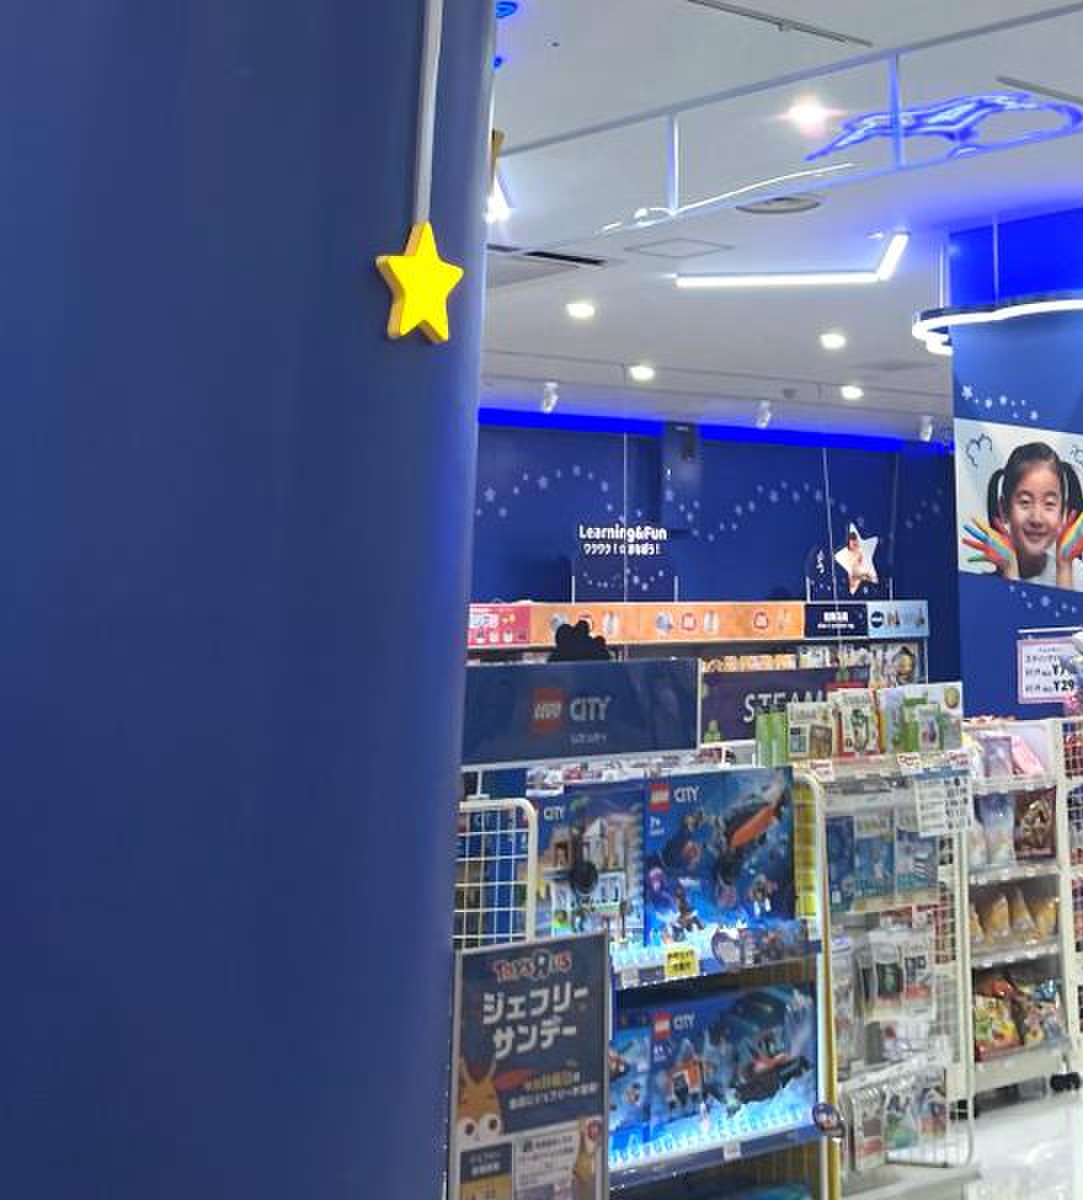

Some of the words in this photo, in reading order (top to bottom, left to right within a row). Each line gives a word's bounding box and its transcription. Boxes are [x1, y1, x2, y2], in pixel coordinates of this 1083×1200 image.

[569, 697, 611, 722] CITY
[673, 786, 700, 803] CITY
[483, 982, 589, 1026] ジェフリー
[672, 1014, 695, 1030] CITY
[493, 1016, 577, 1059] サンデー
